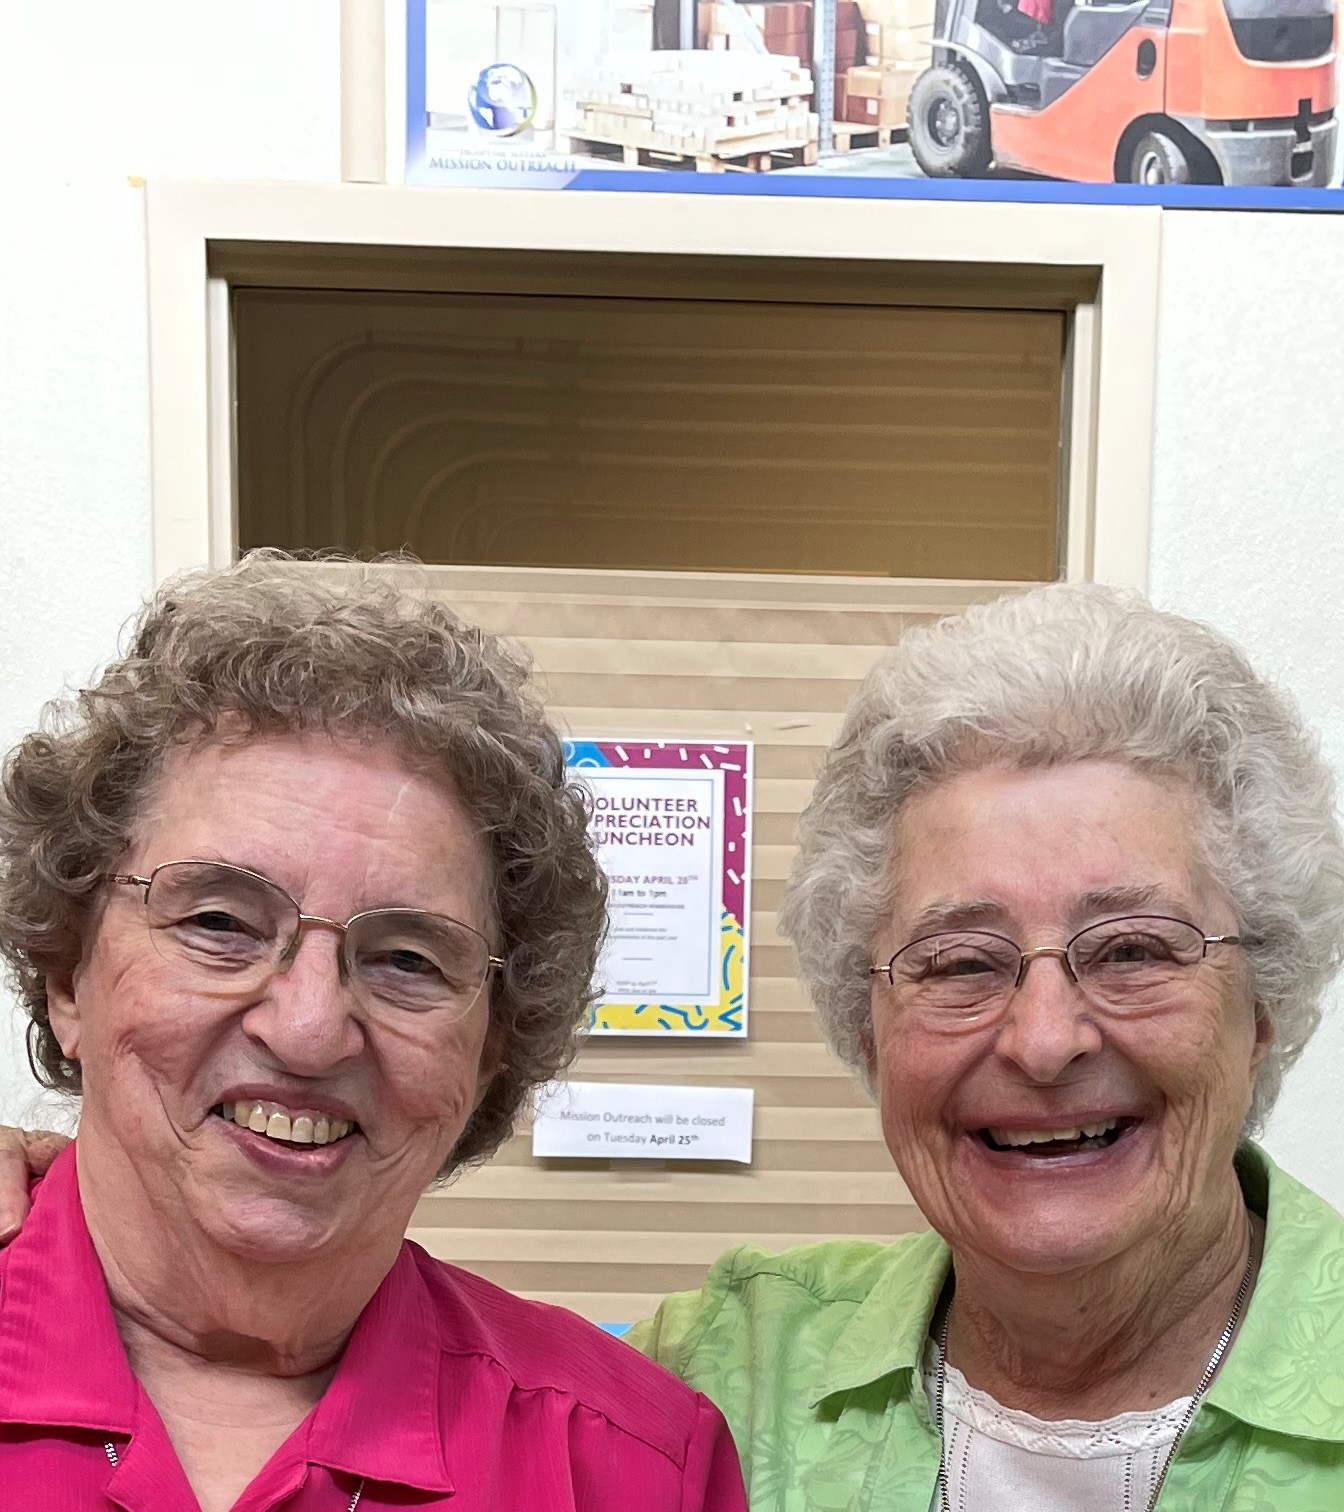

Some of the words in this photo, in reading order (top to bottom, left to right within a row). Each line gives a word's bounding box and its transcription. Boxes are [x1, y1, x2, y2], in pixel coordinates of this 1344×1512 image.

[429, 156, 492, 171] MISSION
[596, 797, 698, 812] OLUNTEER
[595, 814, 710, 829] PRECIATION
[596, 832, 694, 846] UNCHEON
[560, 1112, 600, 1122] Mission
[603, 1112, 652, 1124] Outreach
[655, 1114, 673, 1124] will
[676, 1114, 689, 1125] be
[692, 1115, 725, 1127] closed
[587, 1133, 601, 1141] on
[604, 1133, 648, 1145] Tuesday
[649, 1135, 675, 1145] April
